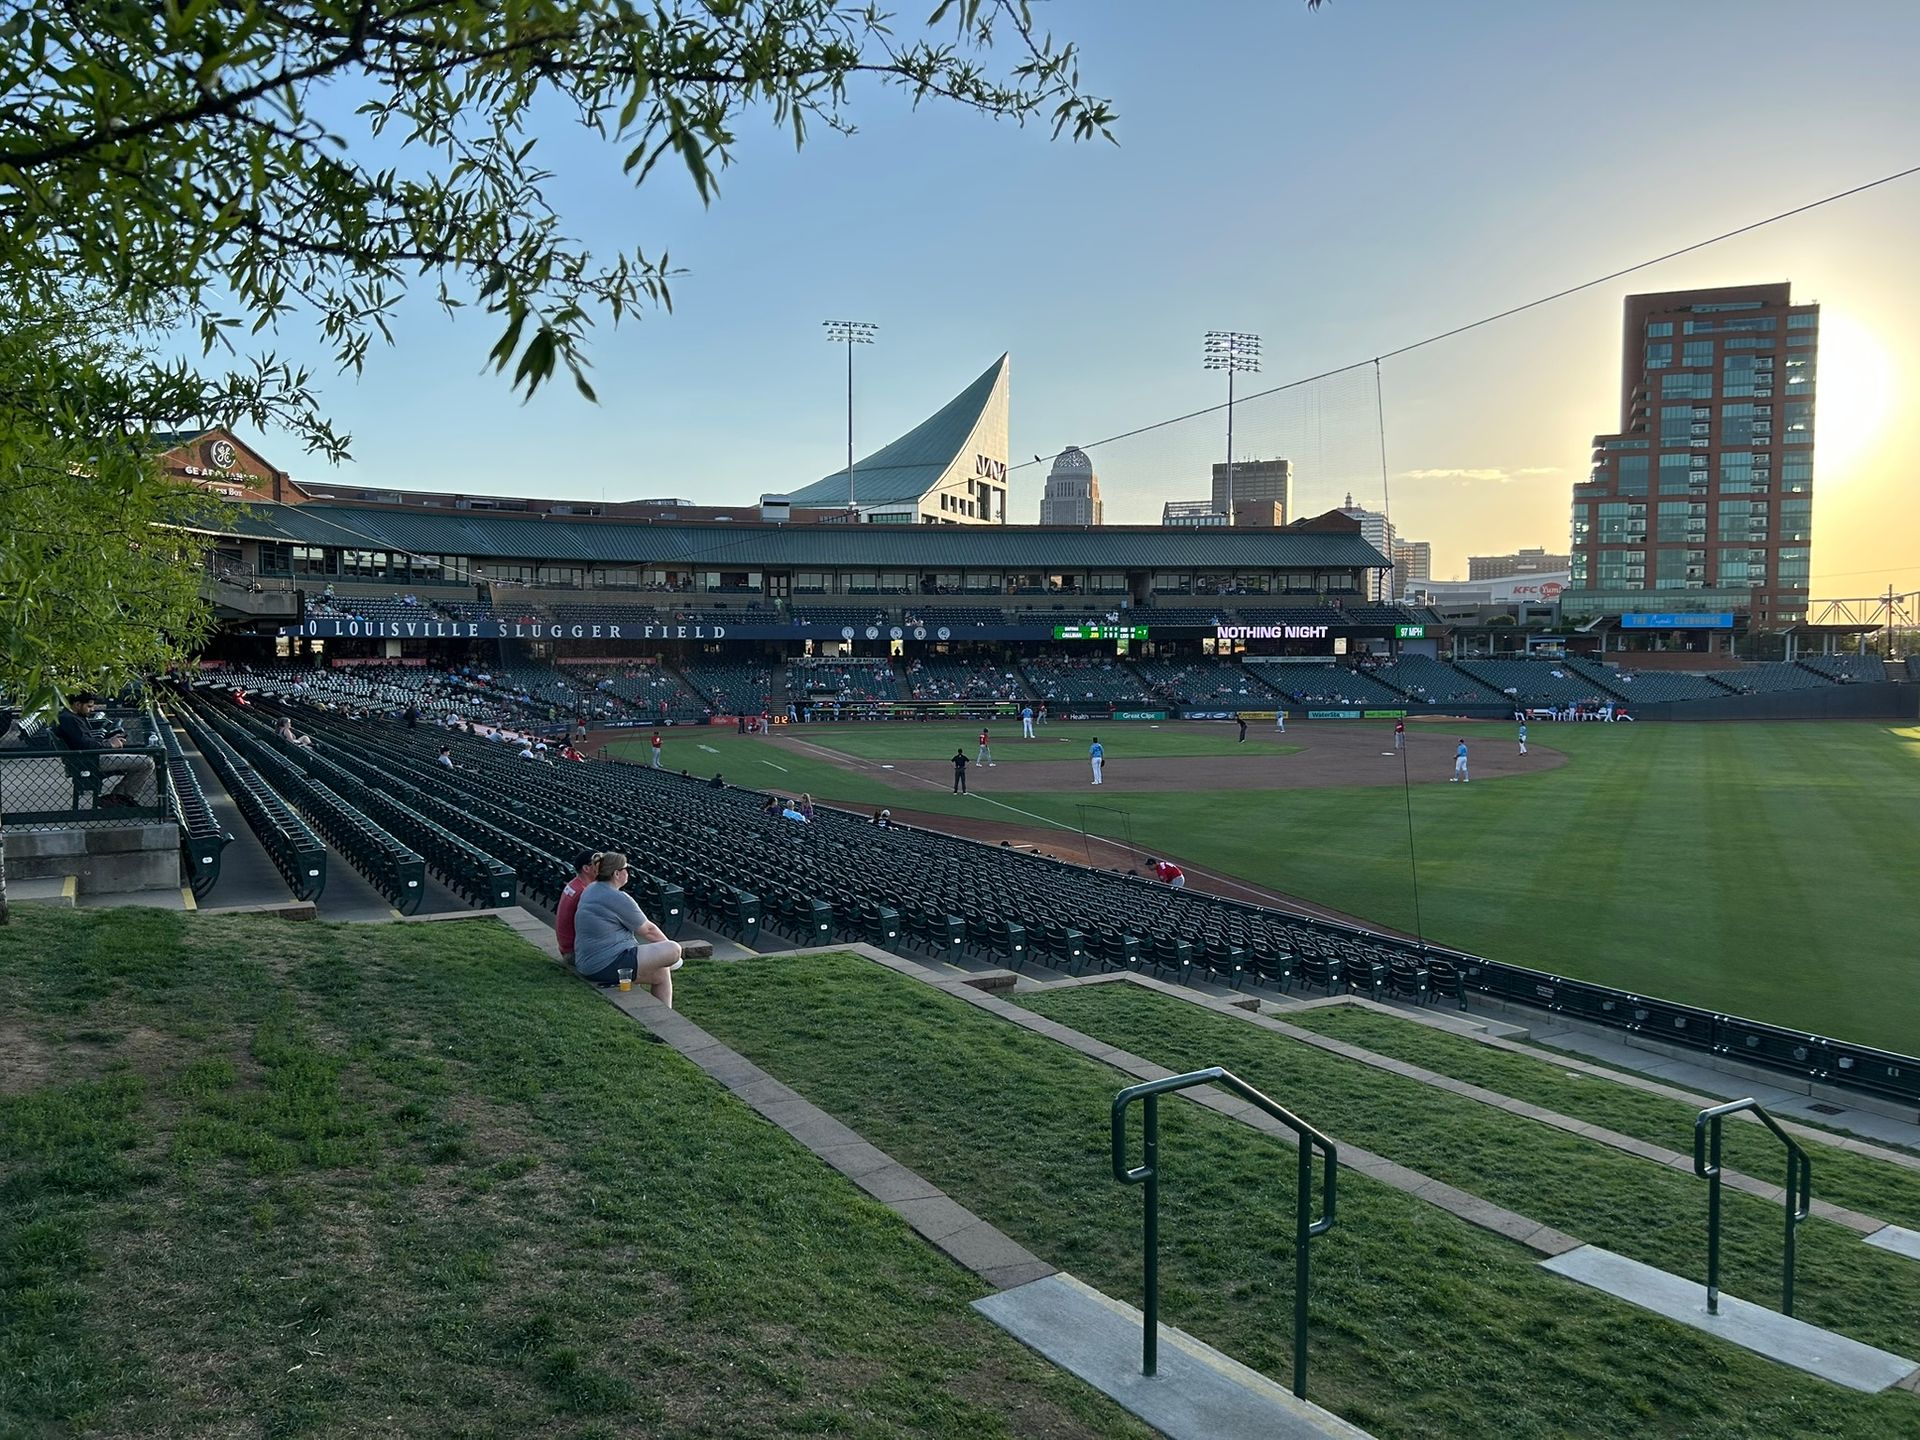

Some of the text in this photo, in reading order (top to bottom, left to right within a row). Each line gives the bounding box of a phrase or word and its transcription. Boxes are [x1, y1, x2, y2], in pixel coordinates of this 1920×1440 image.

[185, 466, 199, 475] GE
[228, 487, 242, 496] Box
[1542, 585, 1562, 594] Yum!
[335, 621, 478, 636] LOUISVILLE
[499, 624, 621, 638] SLUGGER
[645, 626, 725, 638] FIELD
[1217, 626, 1328, 638] NOTHING NIGHT
[1400, 627, 1422, 637] 97 MPH
